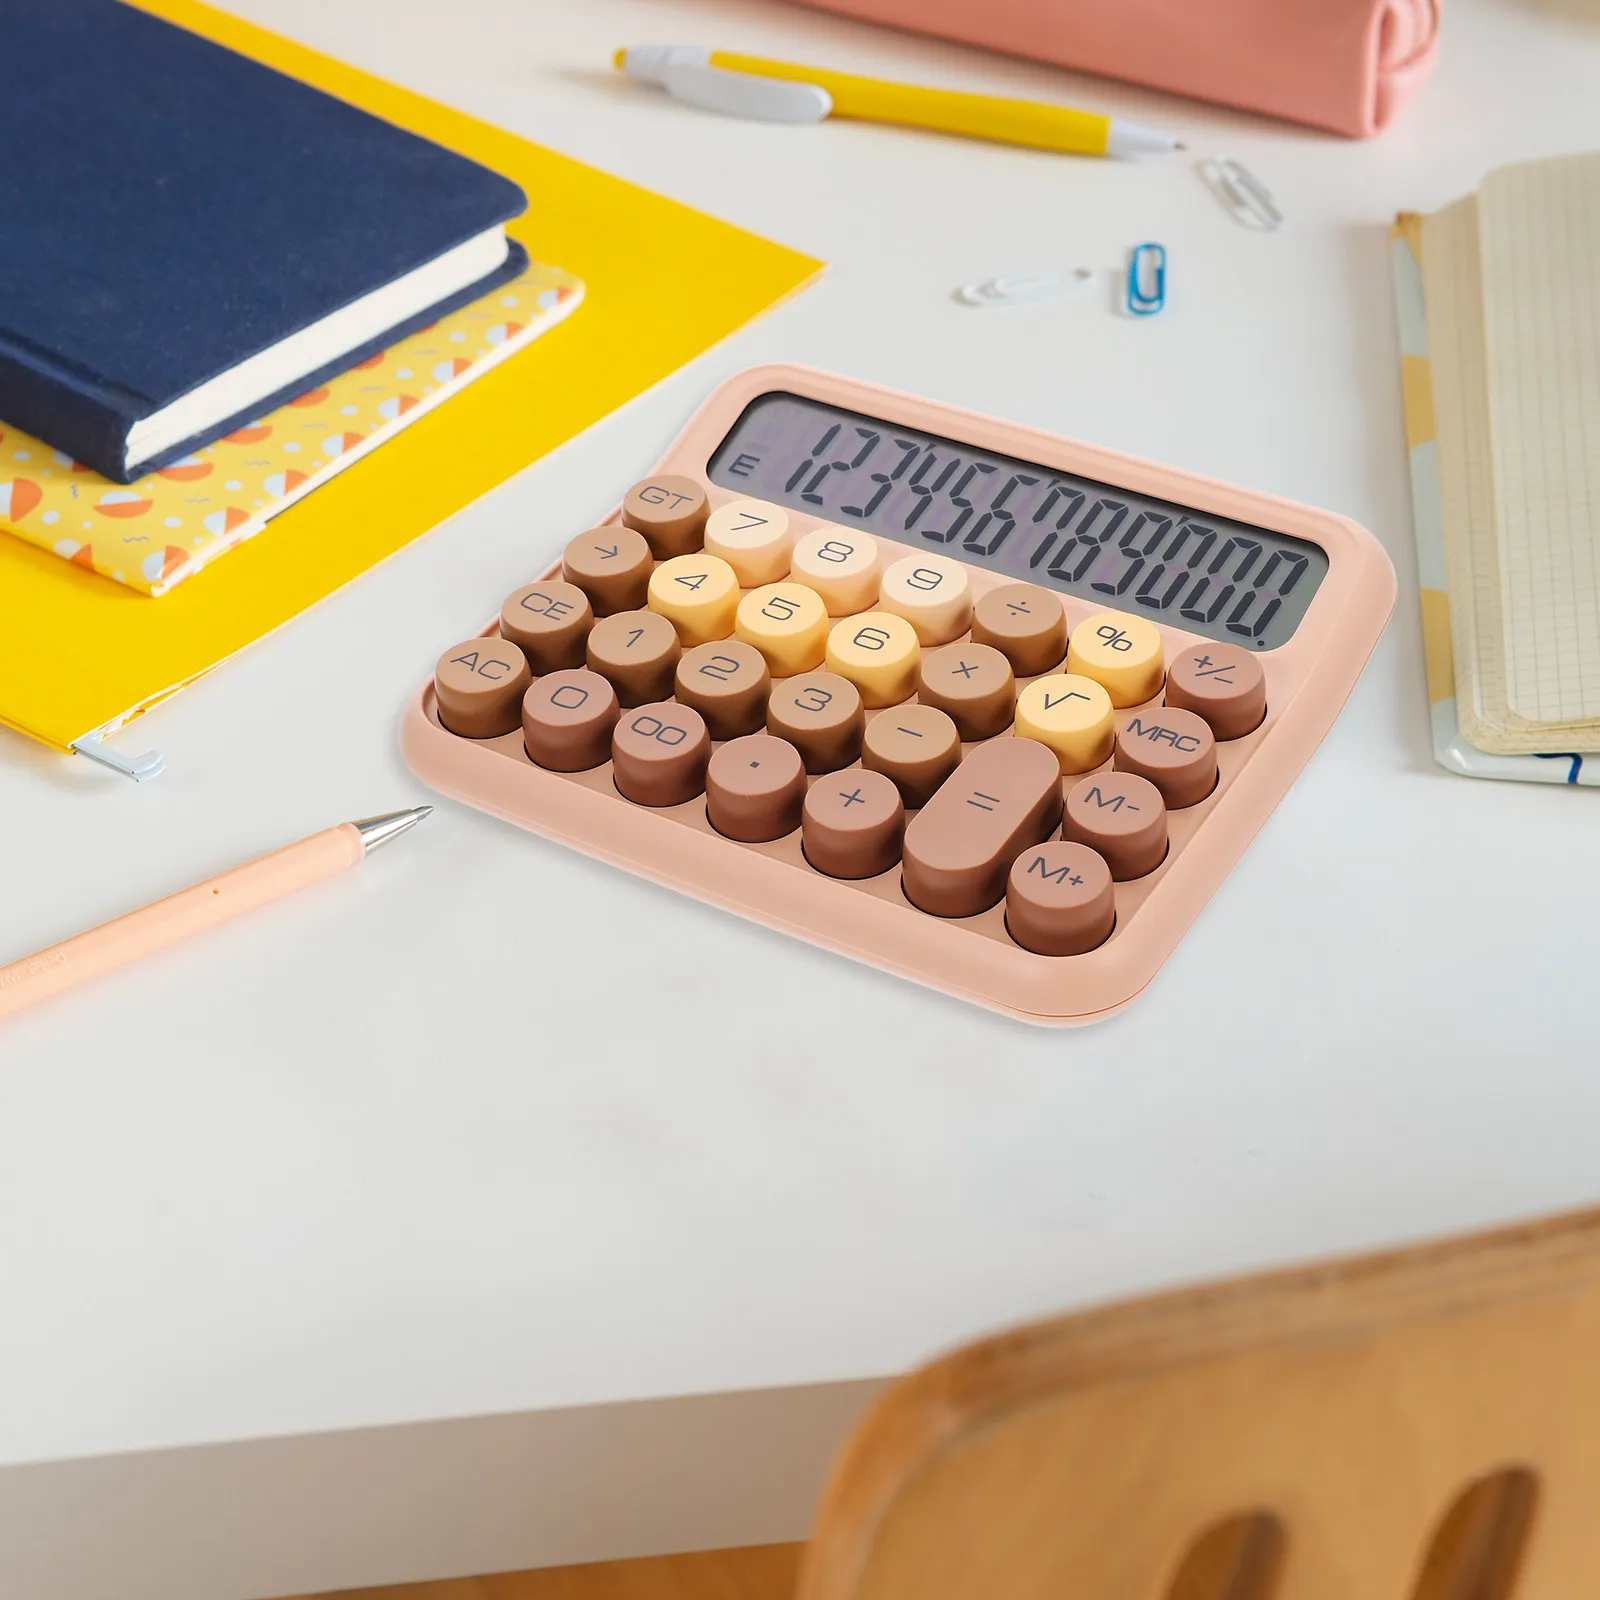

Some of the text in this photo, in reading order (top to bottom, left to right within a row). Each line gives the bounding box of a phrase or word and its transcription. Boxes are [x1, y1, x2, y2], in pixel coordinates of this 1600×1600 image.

[727, 452, 761, 478] E
[638, 485, 693, 510] GT
[729, 512, 769, 532] 7
[817, 540, 855, 564] 8
[673, 573, 709, 592] 4
[906, 567, 943, 591] 9
[520, 591, 574, 621] CE
[761, 596, 802, 622] 5
[625, 628, 645, 648] 1
[852, 626, 891, 652] 6
[1096, 624, 1134, 654] %
[450, 650, 512, 681] AC
[698, 655, 741, 681] 2
[549, 685, 589, 710] 0
[793, 687, 833, 713] 3
[630, 715, 688, 746] 00
[1126, 717, 1202, 754] MRC
[838, 787, 865, 808] +
[966, 791, 1001, 812] =
[1083, 786, 1141, 814] M-
[1026, 856, 1086, 889] M+
